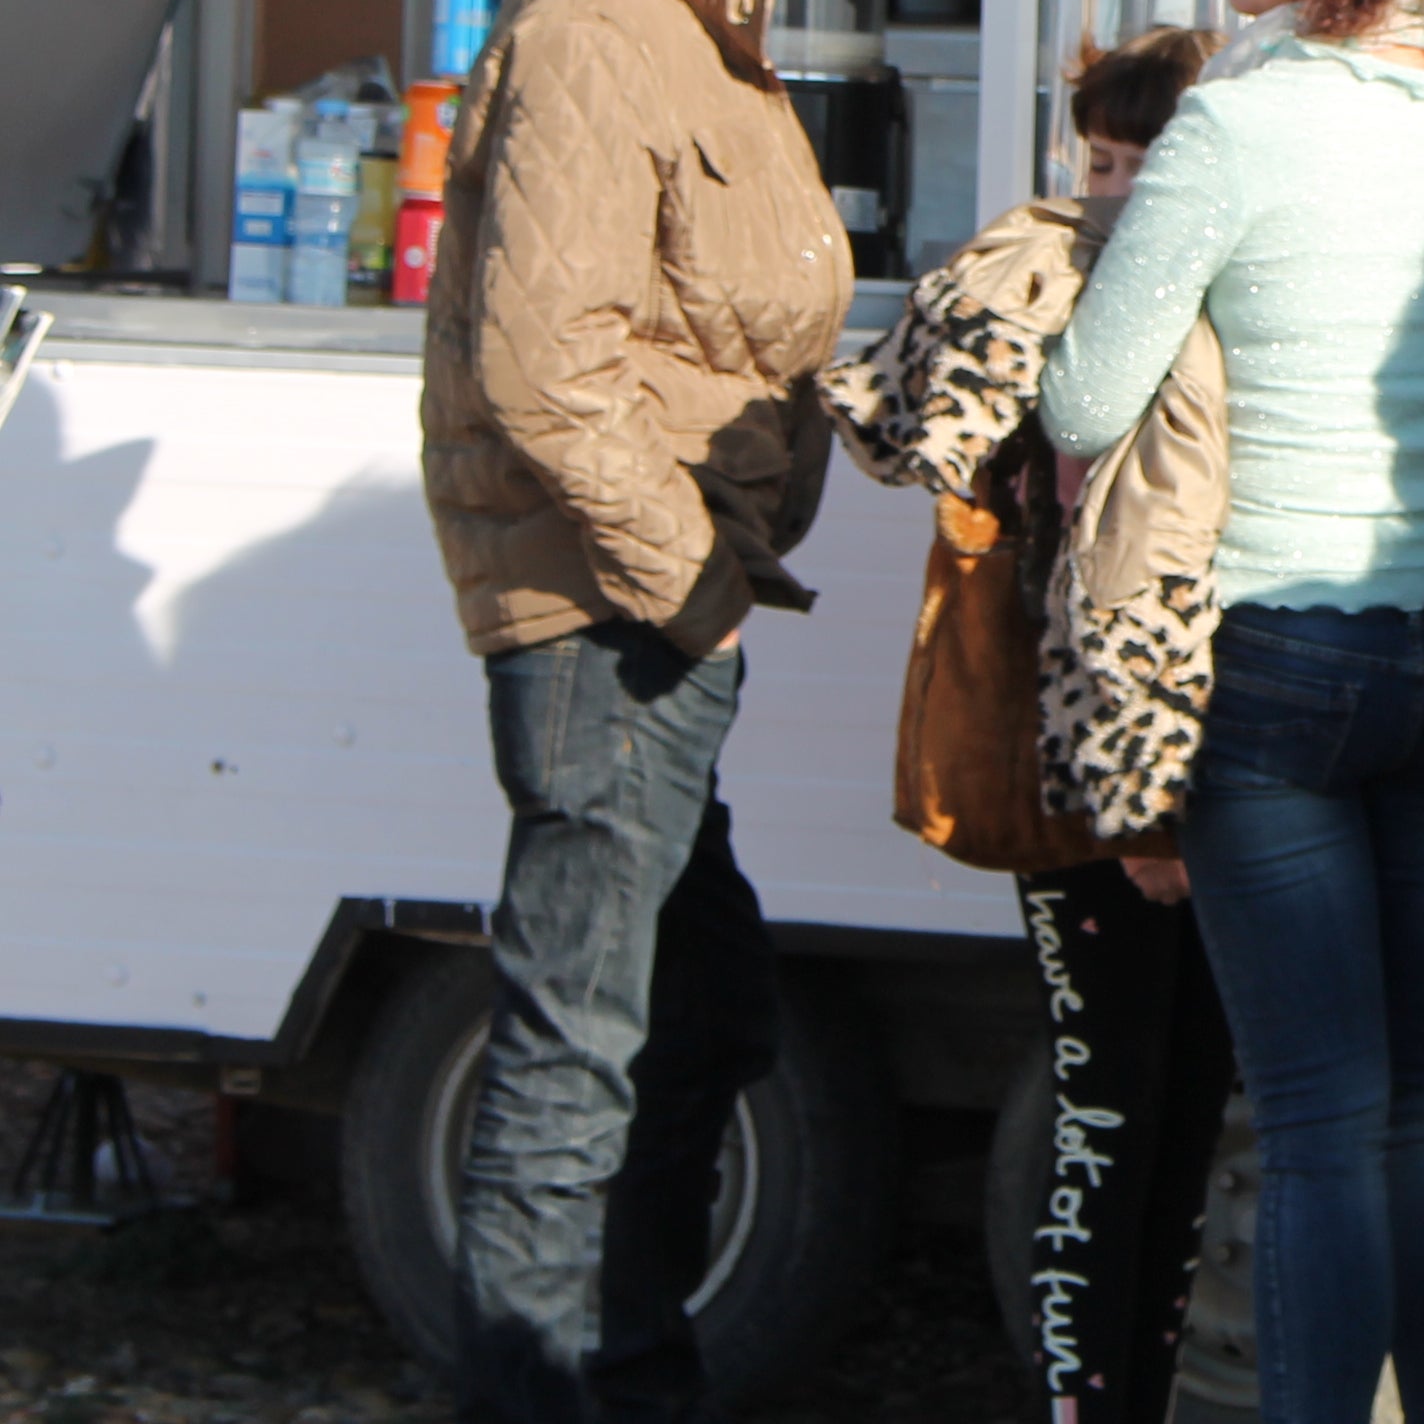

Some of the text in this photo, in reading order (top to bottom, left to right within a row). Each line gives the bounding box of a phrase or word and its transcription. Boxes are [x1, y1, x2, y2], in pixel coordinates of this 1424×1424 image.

[1026, 891, 1126, 1393] have a lot of fun
